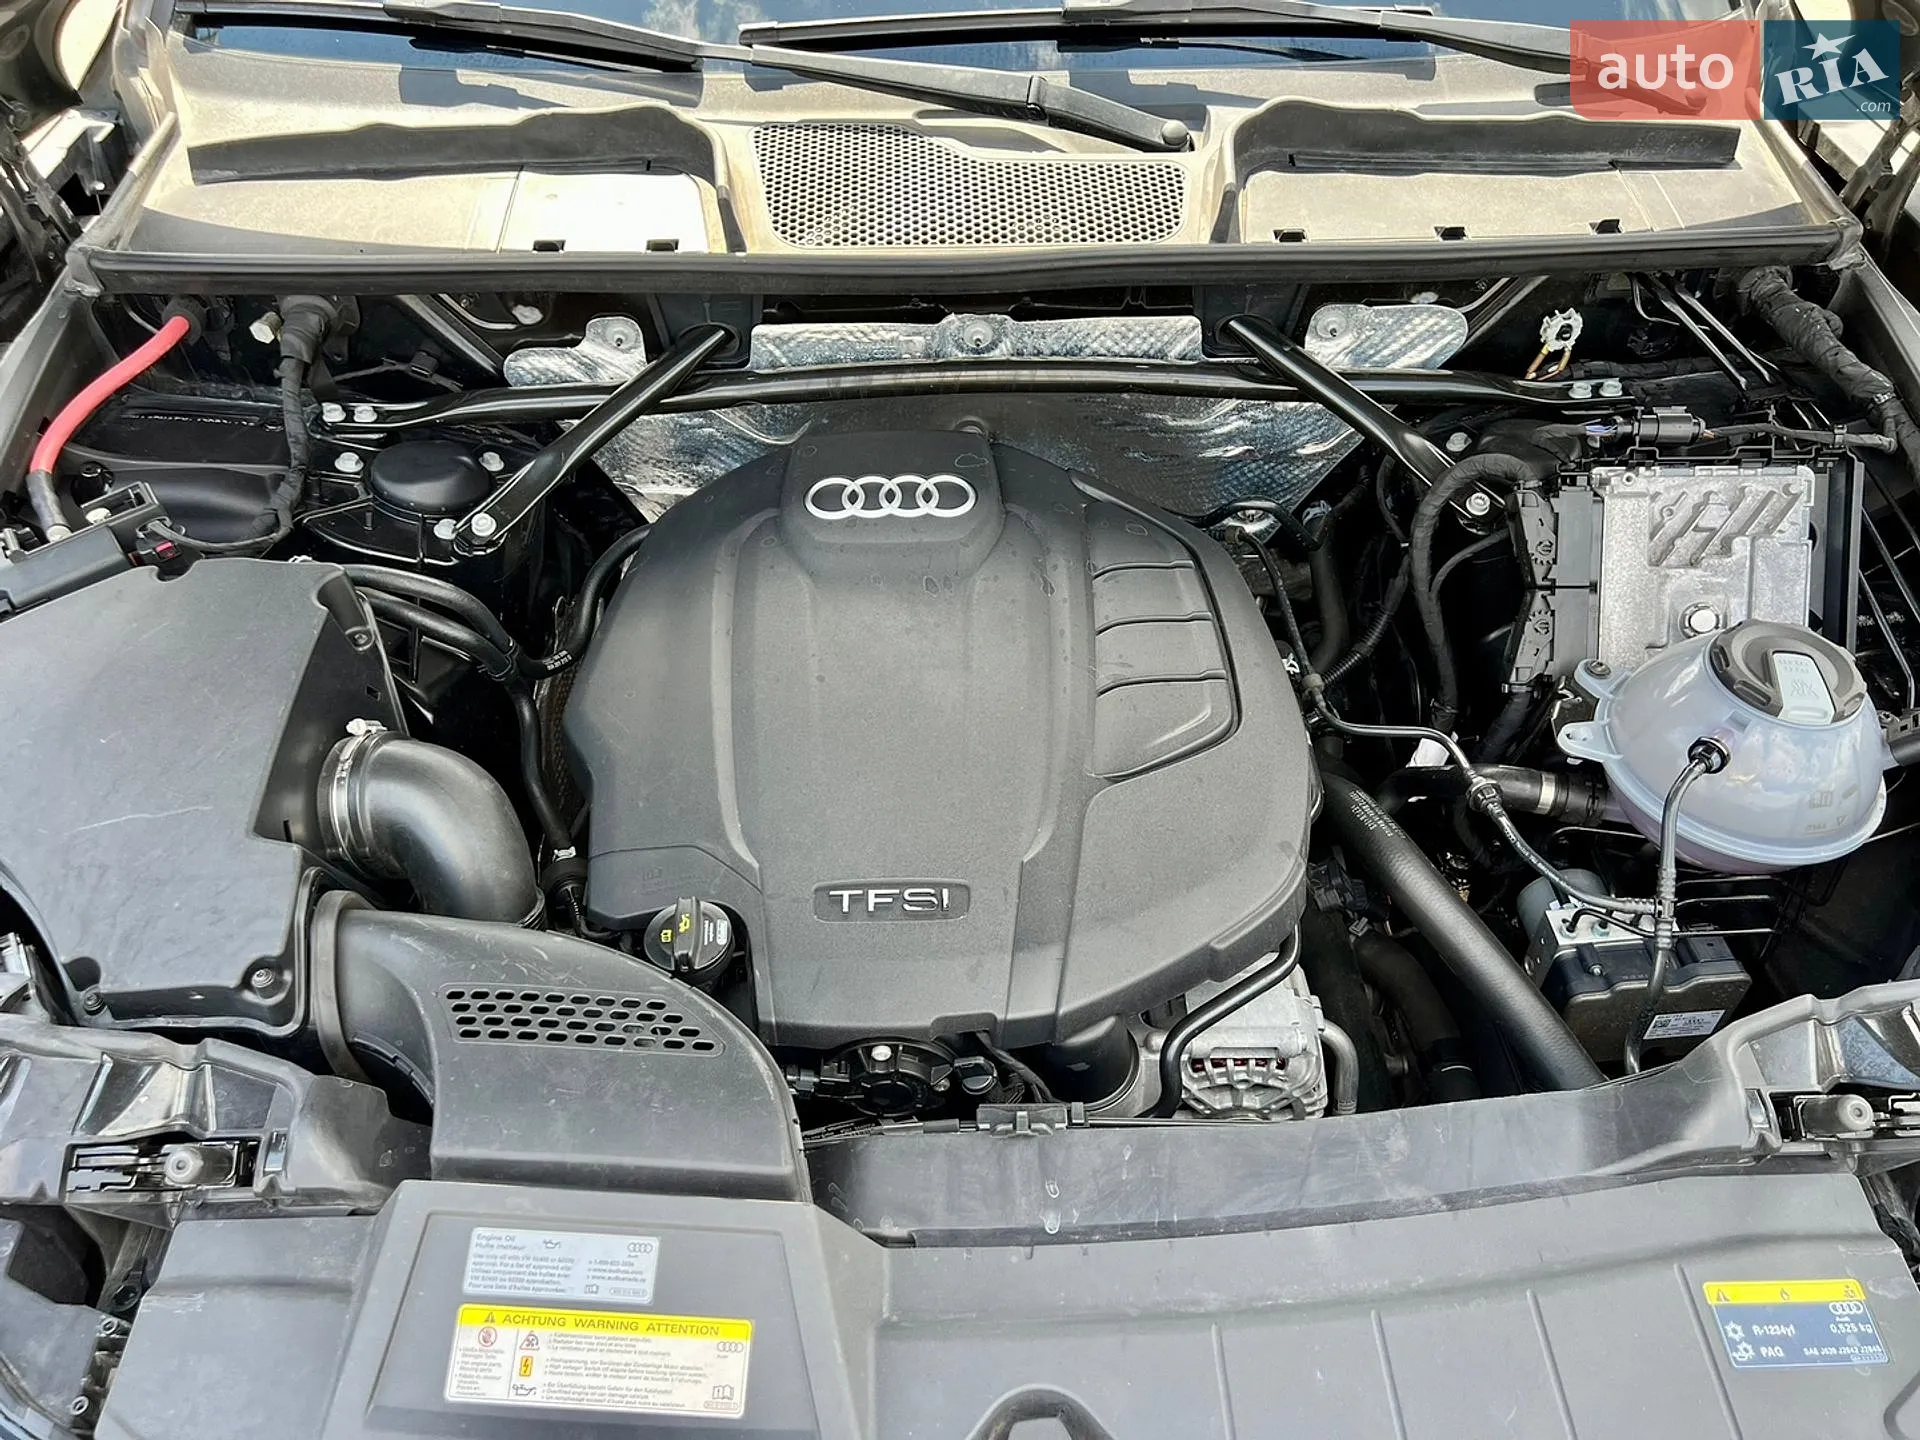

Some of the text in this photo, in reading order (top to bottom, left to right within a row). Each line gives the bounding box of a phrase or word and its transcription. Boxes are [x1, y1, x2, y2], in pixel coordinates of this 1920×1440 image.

[829, 888, 949, 912] TFSI
[476, 1233, 516, 1243] Engine Oil
[502, 1313, 720, 1336] ACHTUNG WARNING ATTENTION
[1858, 1322, 1873, 1334] kg
[1760, 1345, 1785, 1358] PAG
